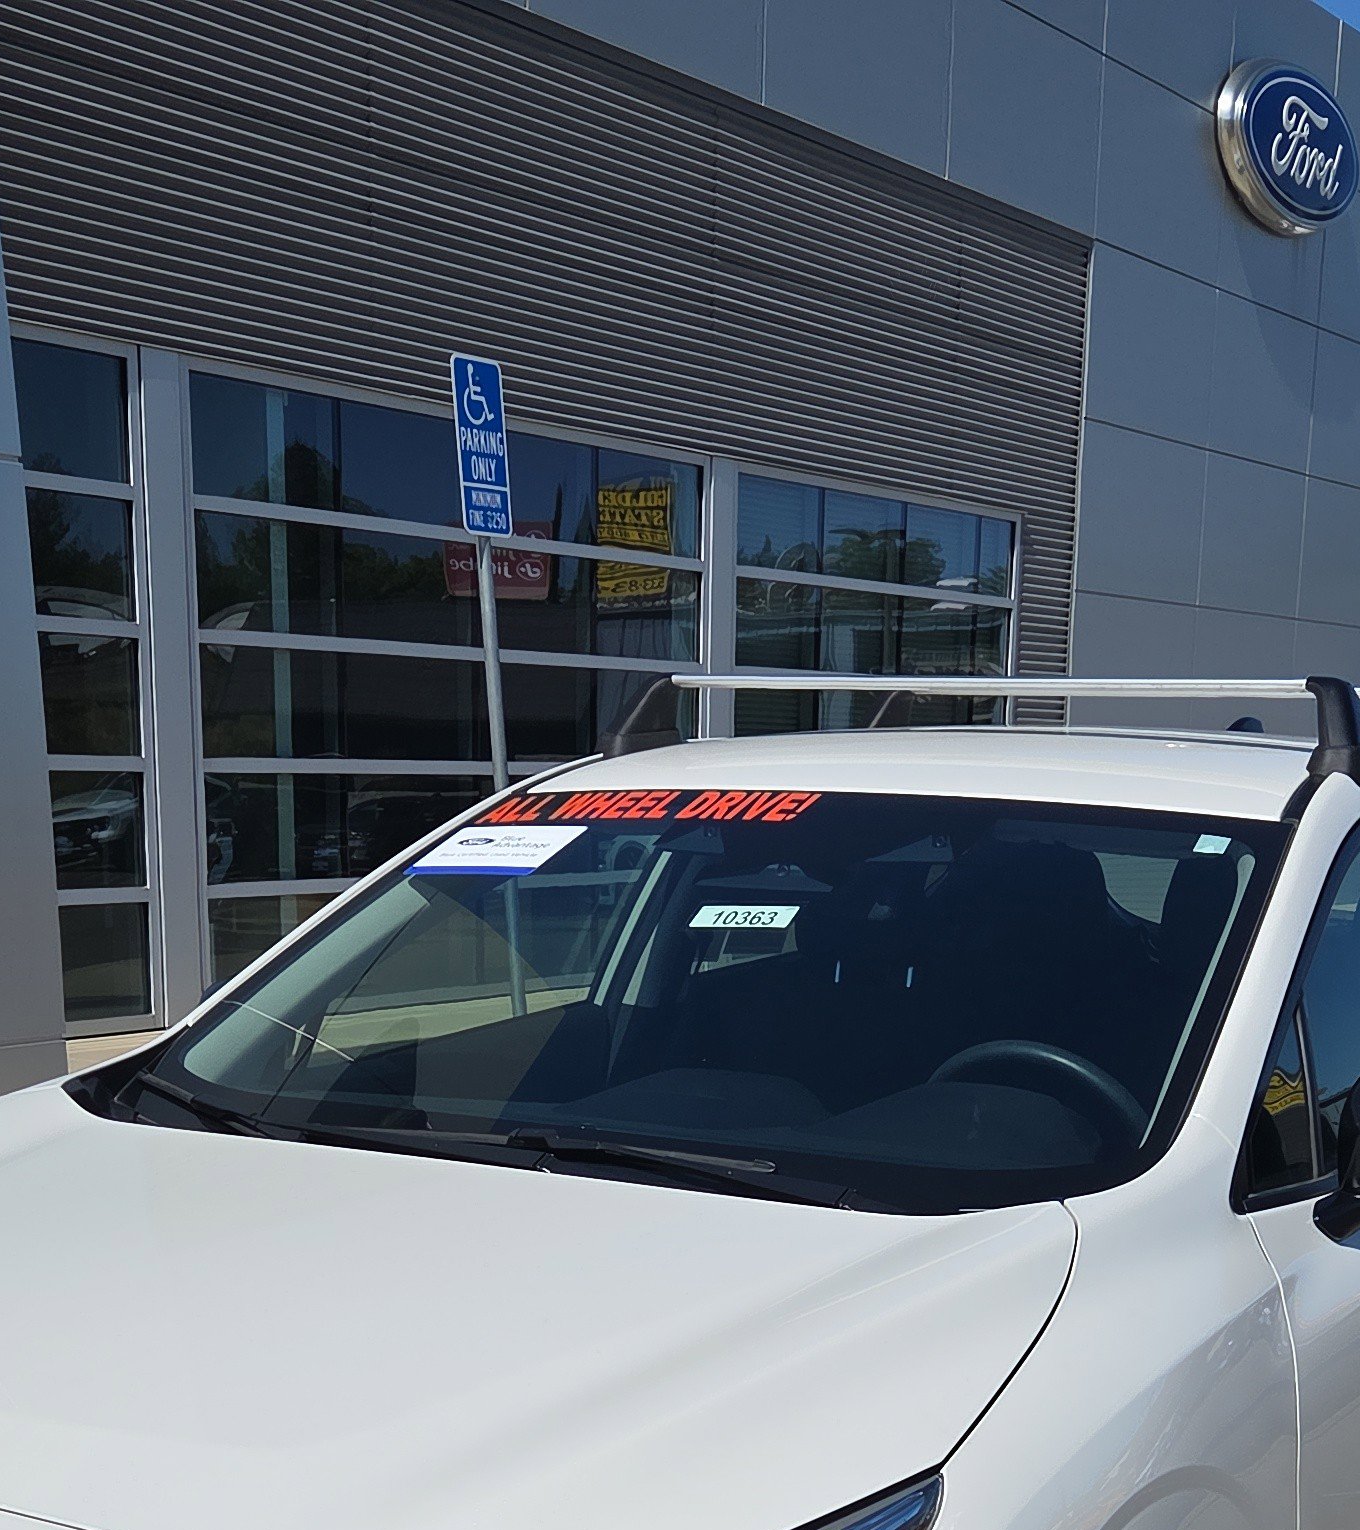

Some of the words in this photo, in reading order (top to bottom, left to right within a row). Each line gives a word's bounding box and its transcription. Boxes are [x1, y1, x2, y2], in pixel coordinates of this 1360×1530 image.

[1270, 95, 1344, 201] Ford
[460, 426, 504, 457] PARKING
[471, 455, 497, 482] ONLY
[469, 509, 486, 528] FINE
[474, 793, 555, 825] ALL
[548, 790, 682, 820] WHEEL
[674, 790, 823, 822] DRIVE!
[711, 910, 779, 927] 10363
